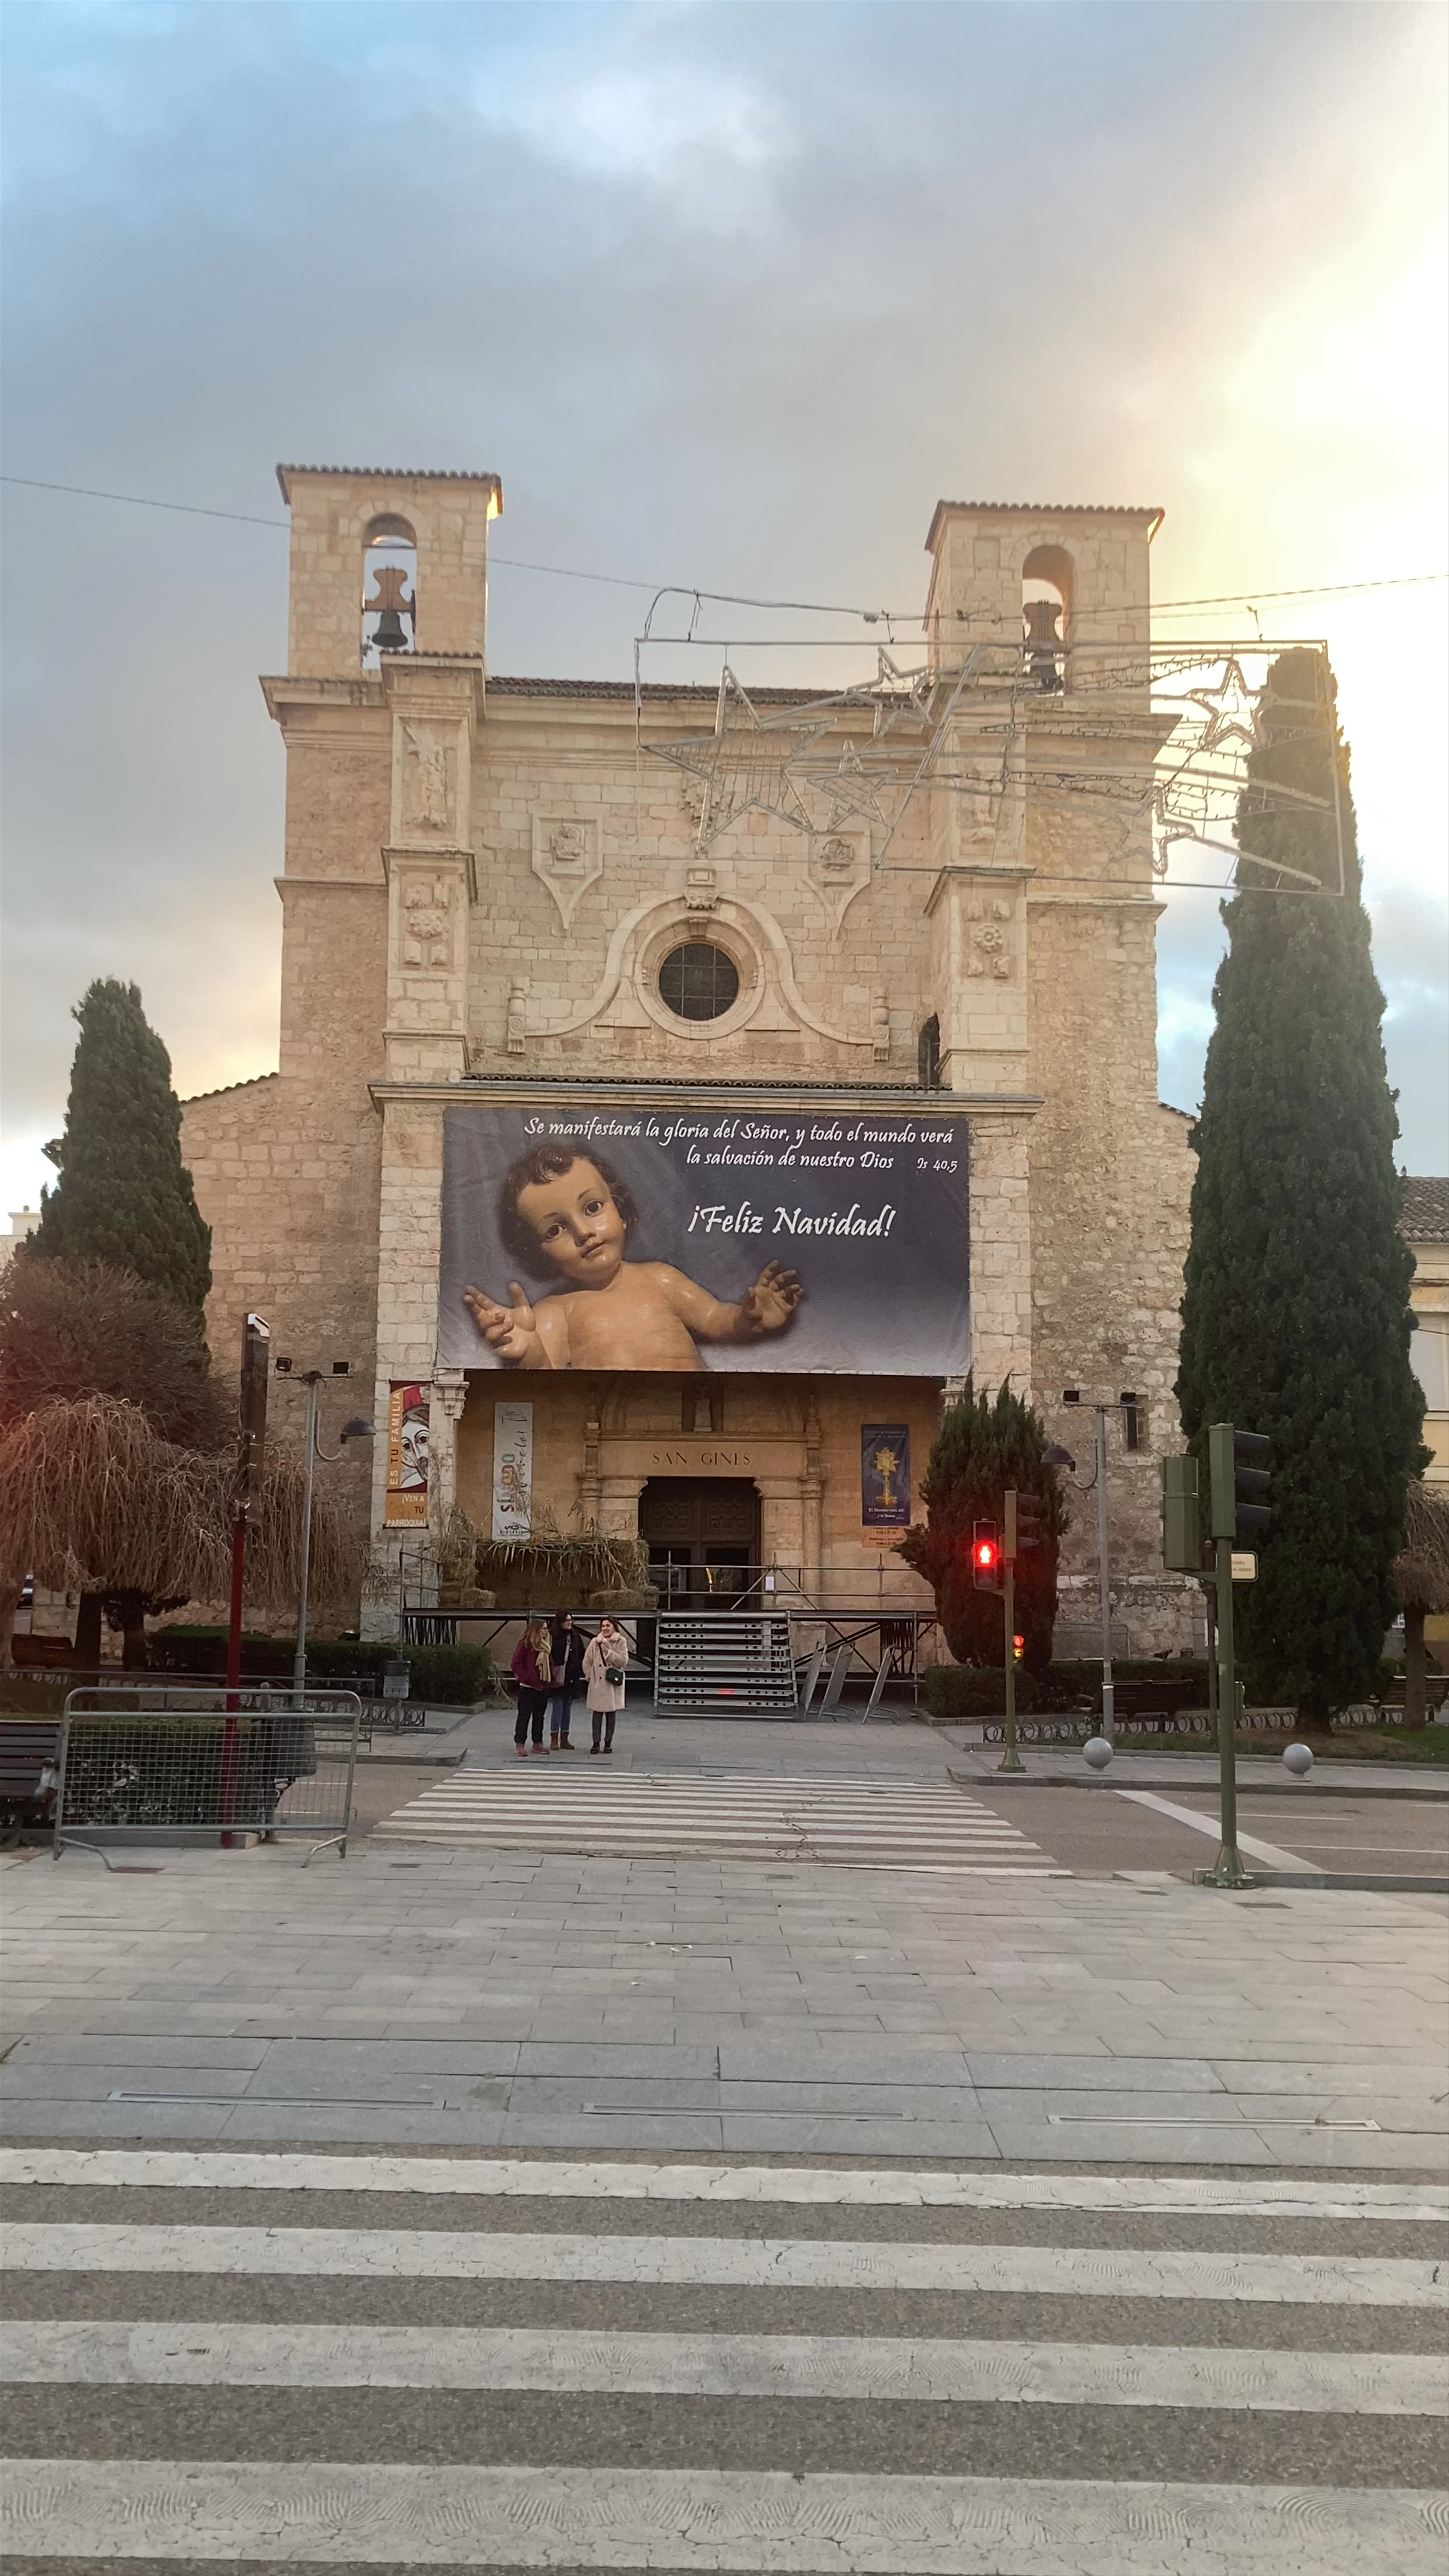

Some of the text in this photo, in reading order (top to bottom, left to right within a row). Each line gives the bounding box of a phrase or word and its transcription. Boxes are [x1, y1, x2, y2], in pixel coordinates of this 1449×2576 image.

[524, 1116, 954, 1149] Se manifestará la gloria del Señor, y todo el mundo verá
[686, 1144, 958, 1173] la salvación de nuestro Dios Is 40,5
[687, 1201, 896, 1237] ¡Feliz Navidad!
[390, 1392, 401, 1485] ES TU FAMILIA
[652, 1452, 687, 1465] SAN
[386, 1518, 426, 1527] PARROQUIA!
